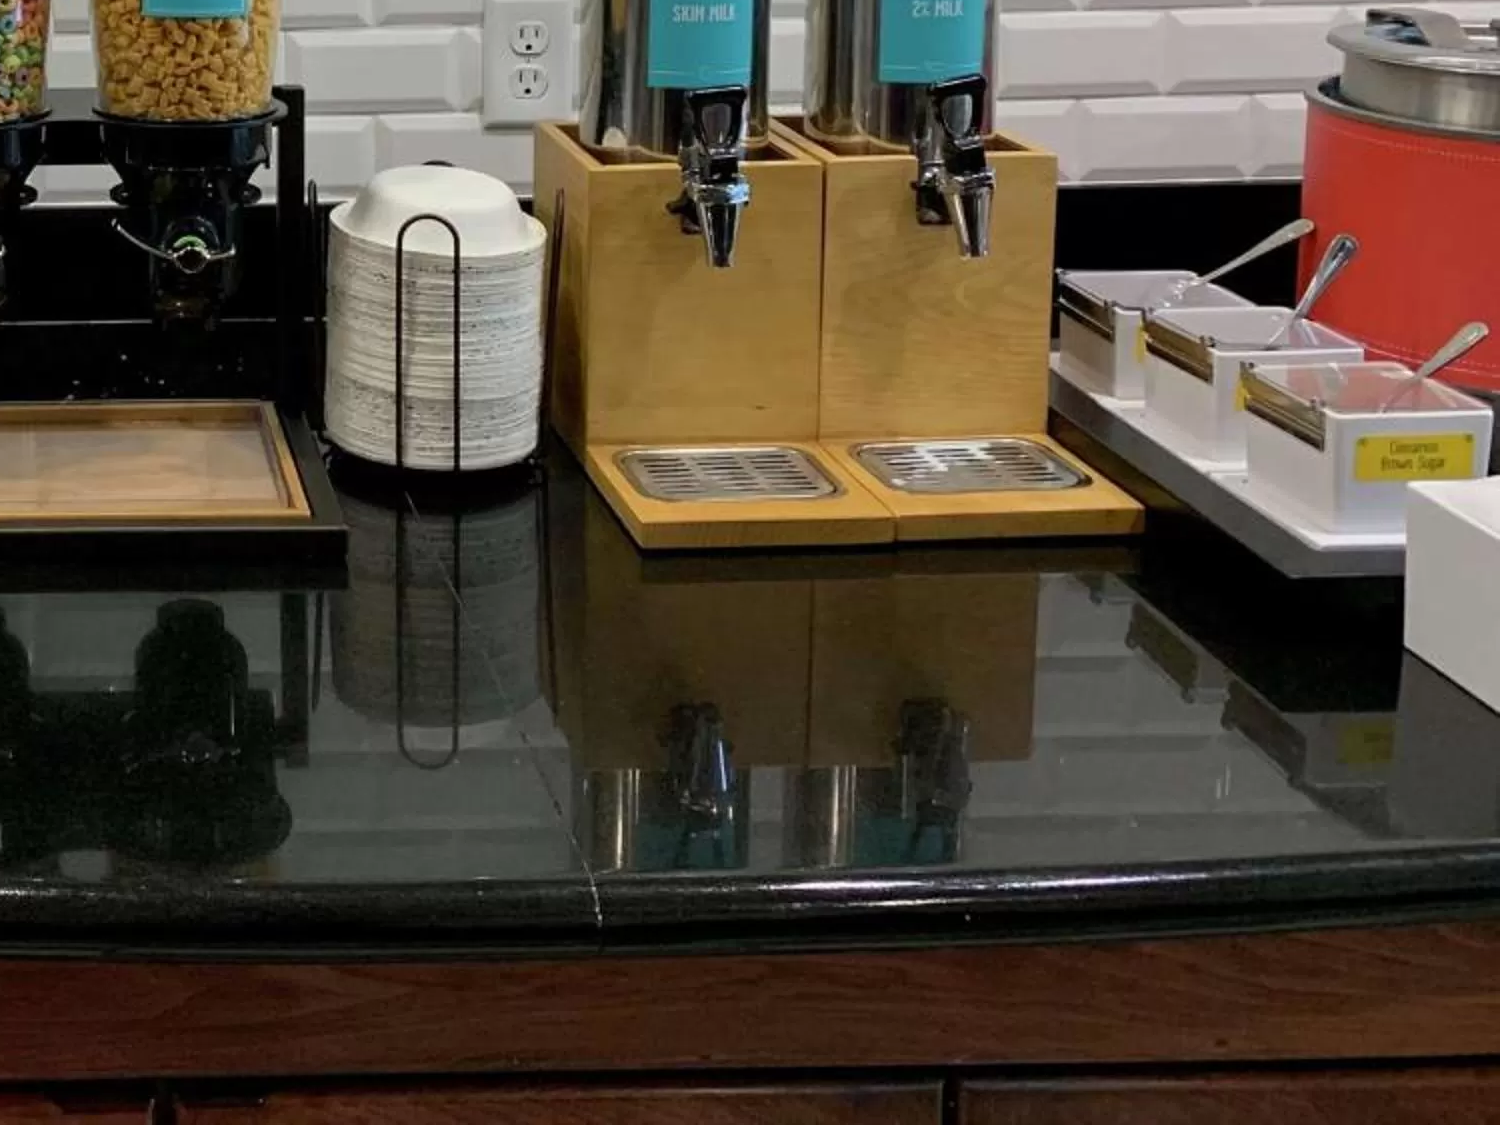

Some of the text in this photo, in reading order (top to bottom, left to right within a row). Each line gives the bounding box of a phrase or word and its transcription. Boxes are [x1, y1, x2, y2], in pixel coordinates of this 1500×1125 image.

[672, 2, 736, 23] SKIM MILK
[912, 0, 931, 18] 2%
